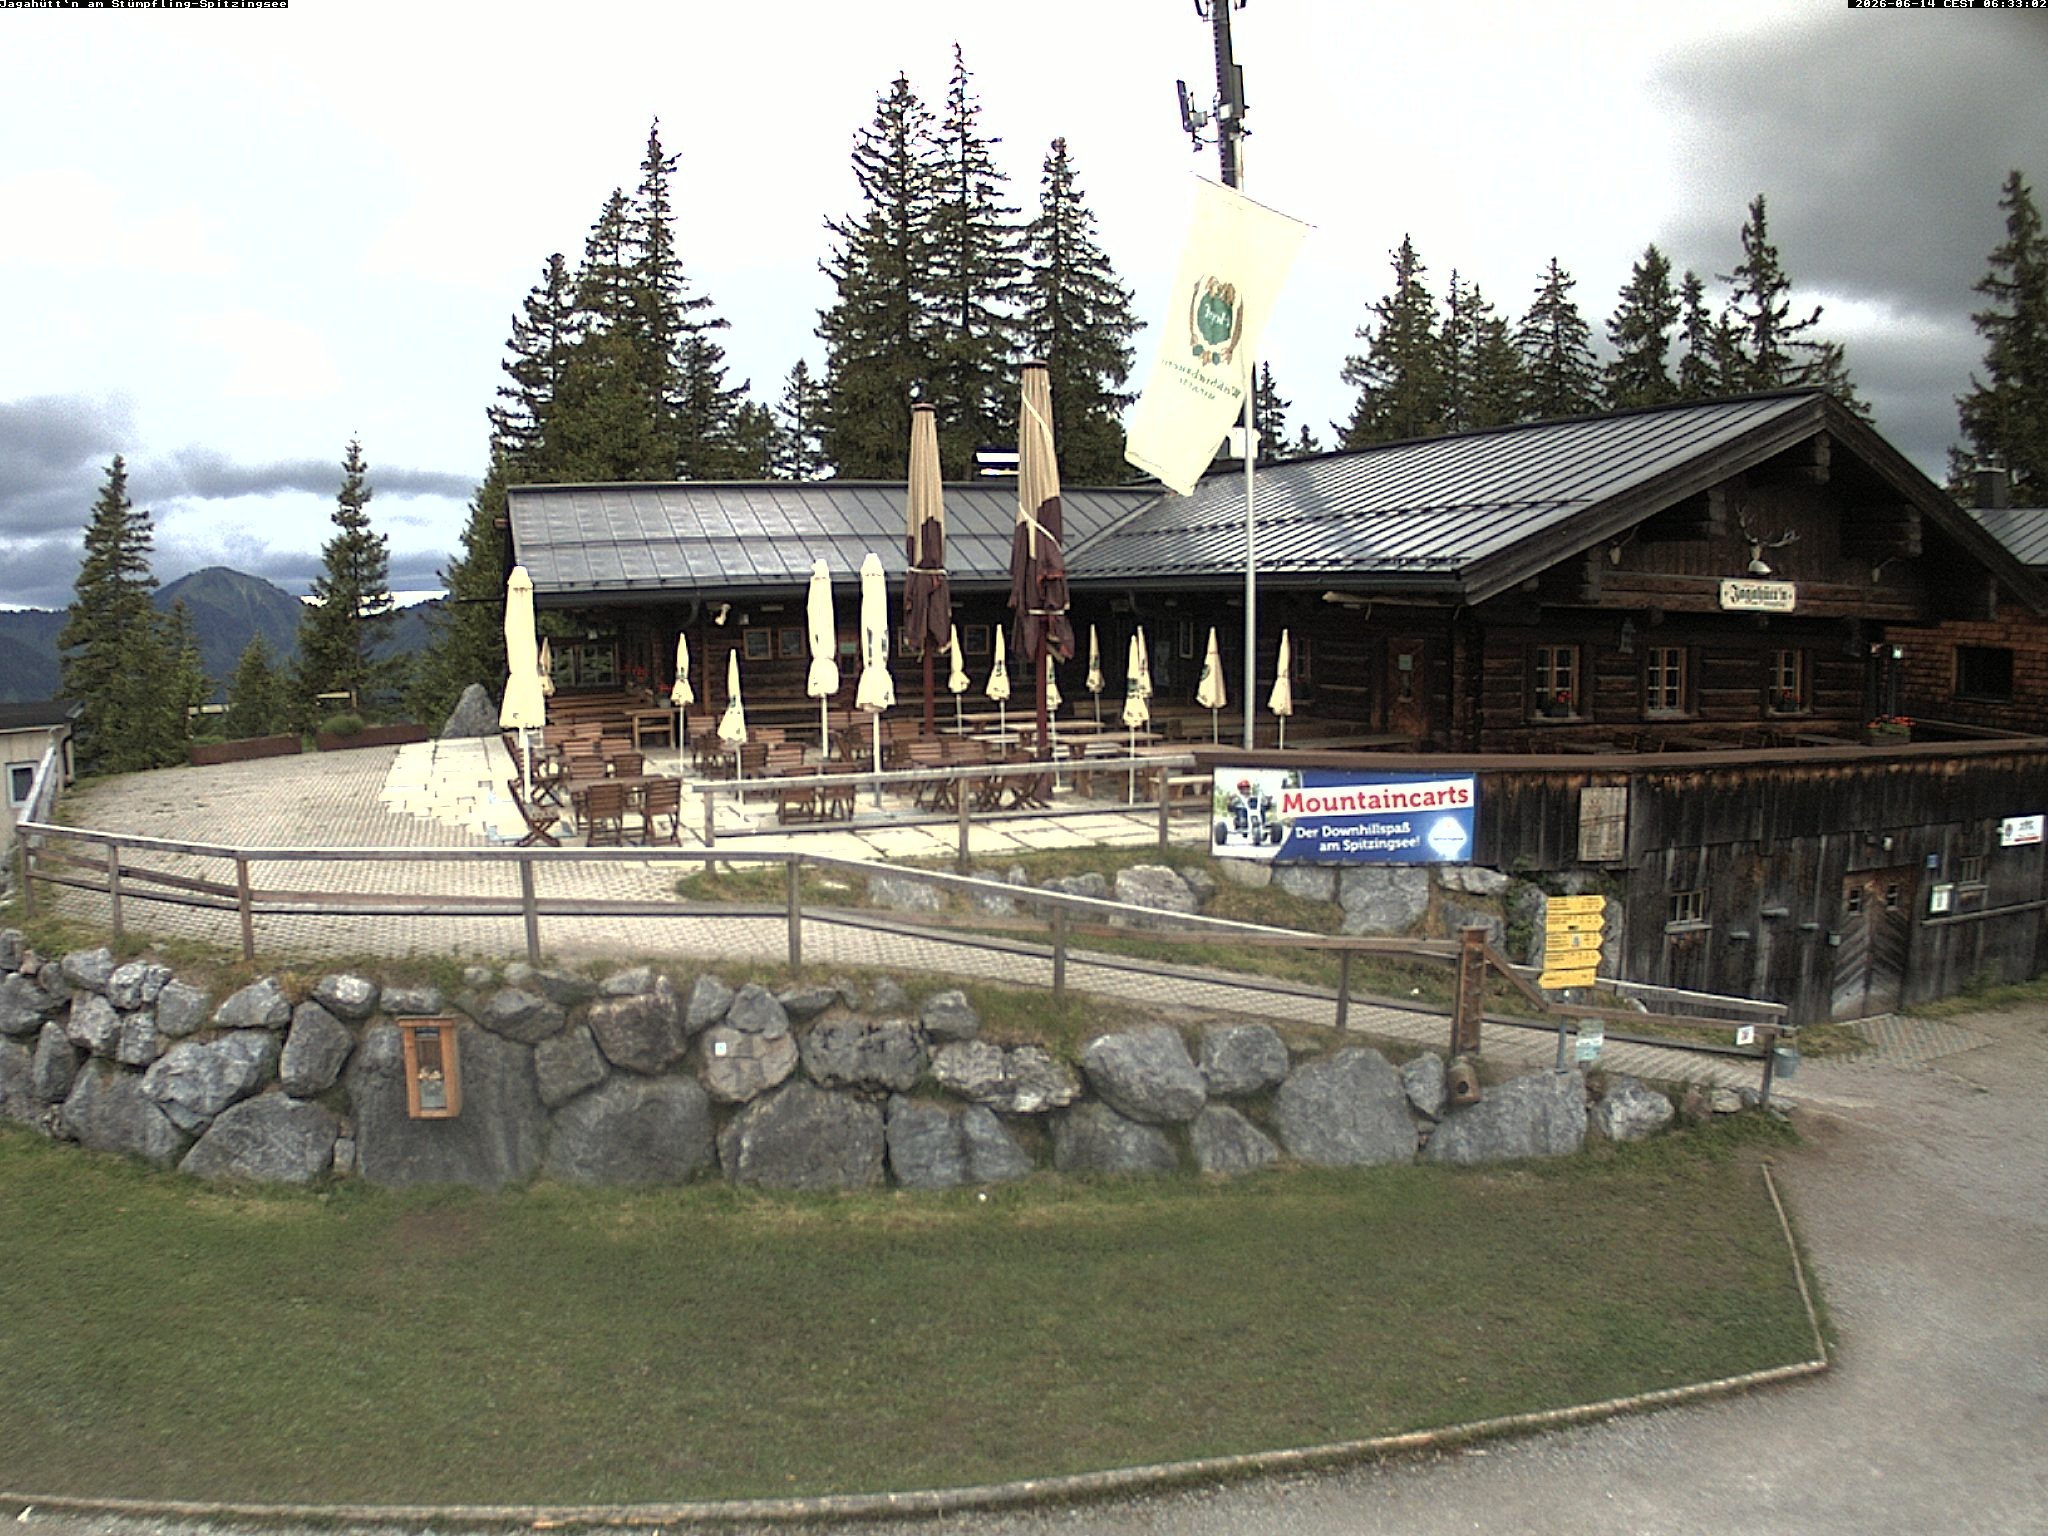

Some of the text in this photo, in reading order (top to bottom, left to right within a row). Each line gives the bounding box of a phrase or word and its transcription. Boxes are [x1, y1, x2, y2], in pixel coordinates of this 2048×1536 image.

[1282, 786, 1469, 813] Mountaincarts
[1296, 822, 1411, 838] Der Downhillspaß
[1319, 836, 1420, 852] am Spitzingsee!
